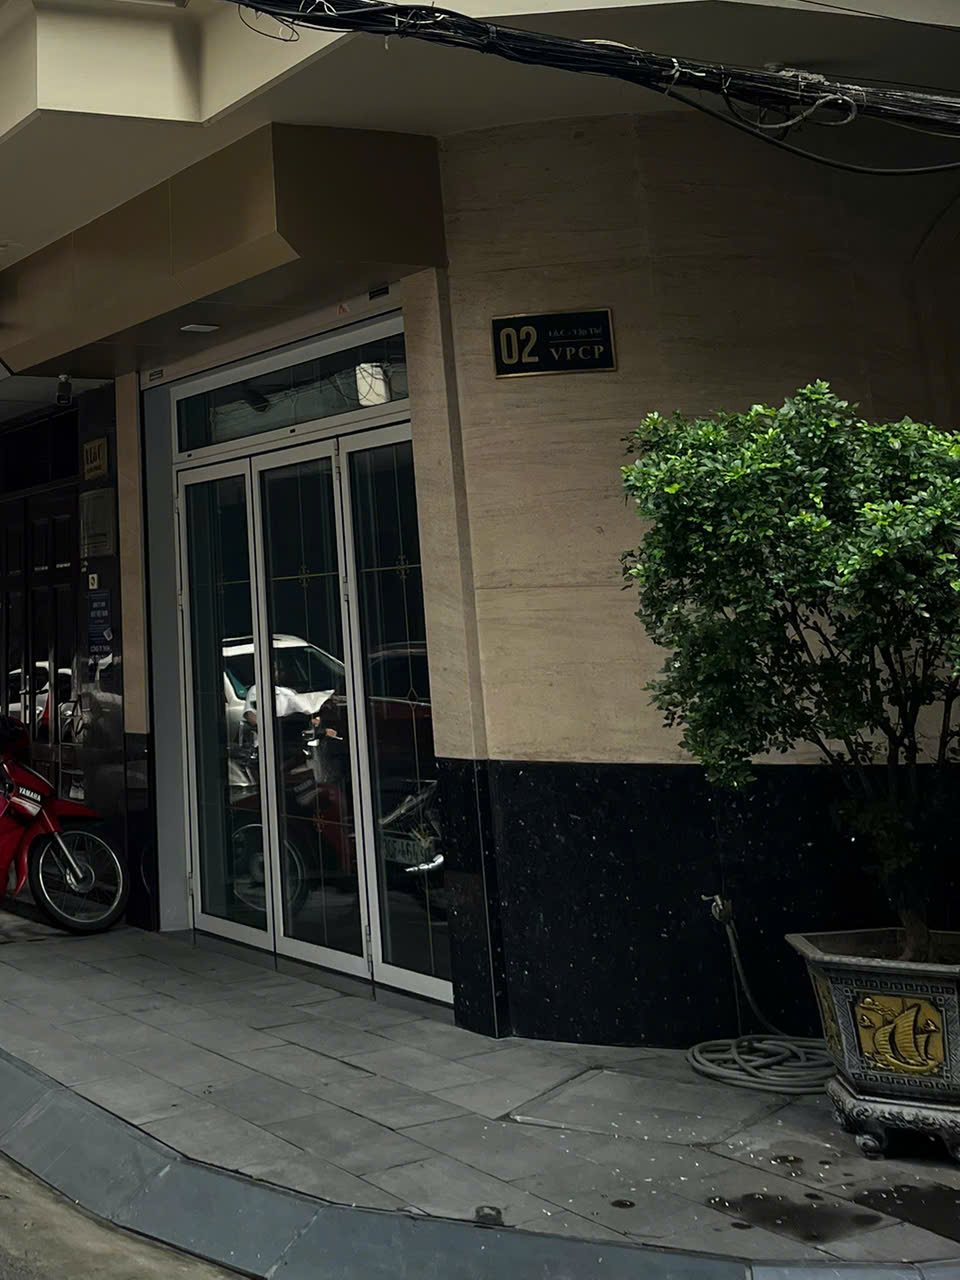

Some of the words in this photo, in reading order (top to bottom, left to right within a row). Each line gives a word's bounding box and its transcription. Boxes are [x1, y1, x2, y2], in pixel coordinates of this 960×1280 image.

[499, 326, 539, 364] 02
[550, 345, 604, 361] VPCP
[19, 786, 41, 801] YAMAHA
